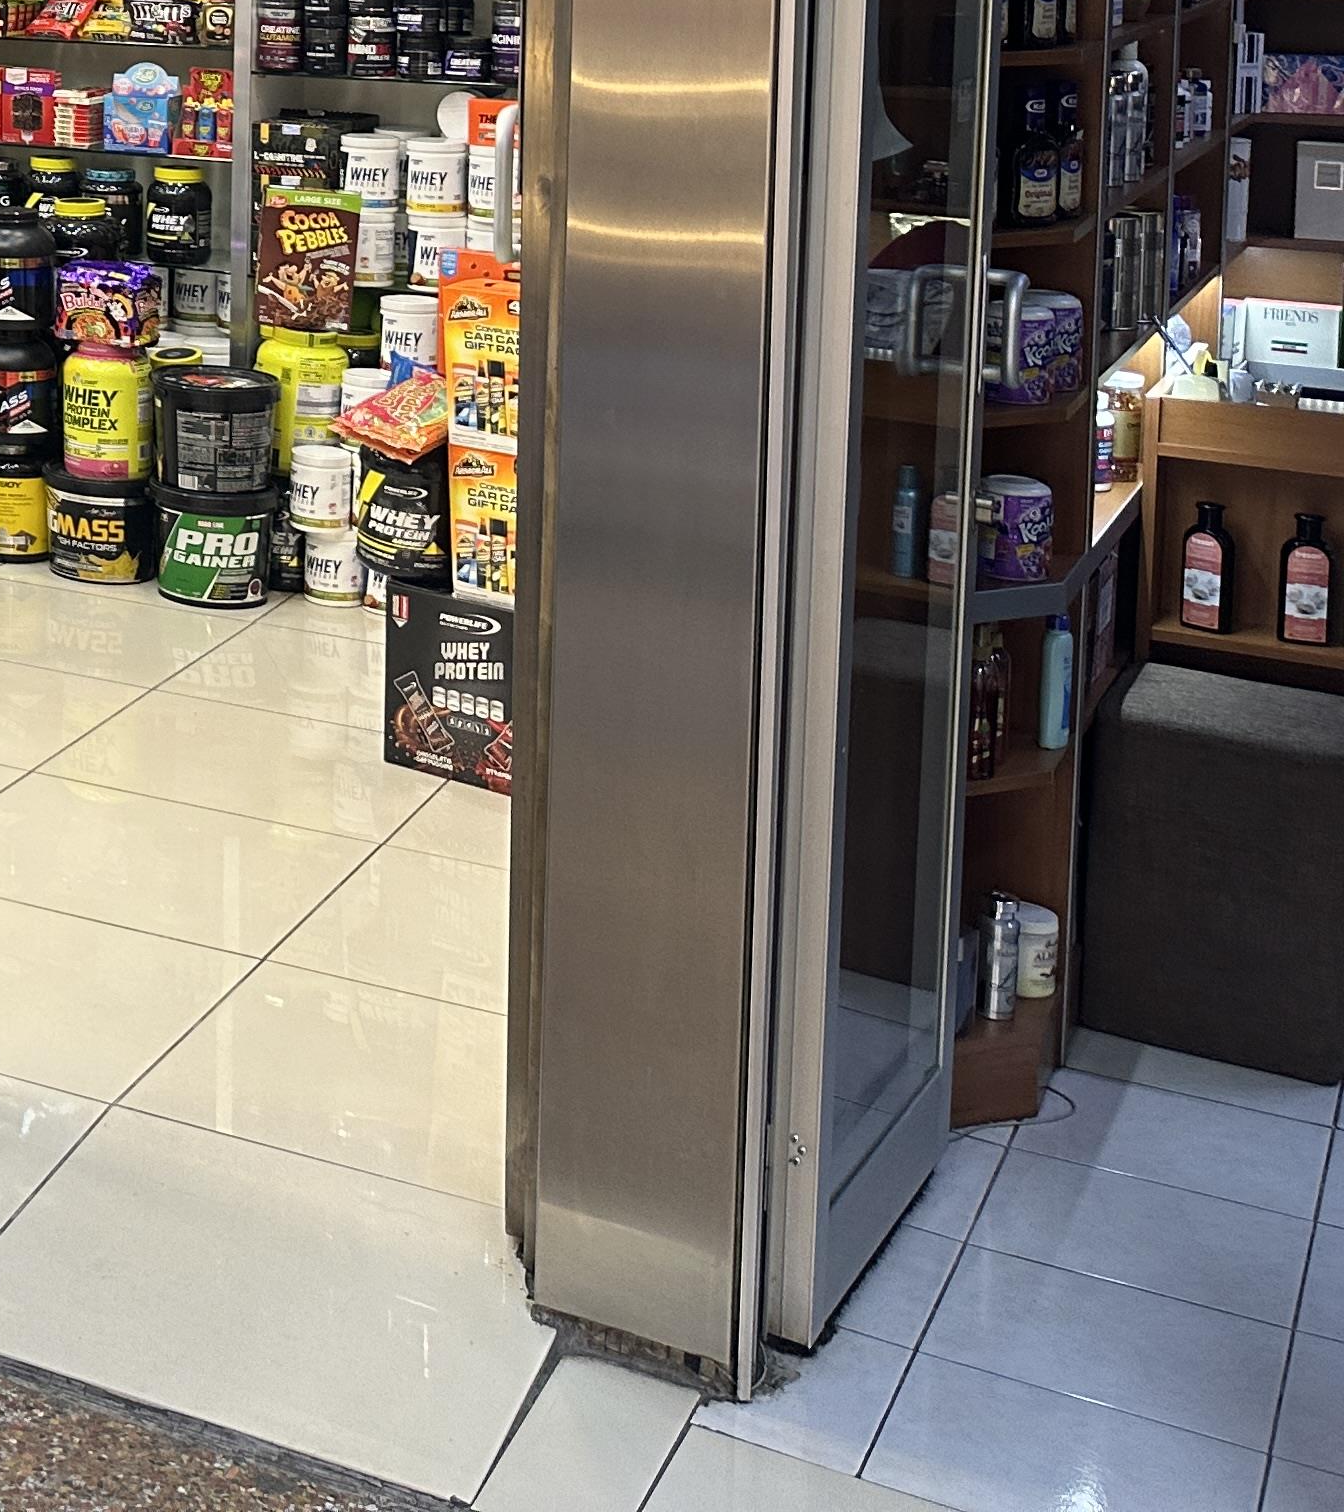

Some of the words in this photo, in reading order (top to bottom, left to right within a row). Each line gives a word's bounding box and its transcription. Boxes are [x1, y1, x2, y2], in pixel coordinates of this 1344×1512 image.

[350, 167, 389, 181] WHEY
[411, 171, 447, 186] WHEY
[294, 195, 319, 204] LARGE
[321, 196, 341, 206] SIZE
[151, 214, 189, 226] WHEY
[279, 209, 341, 230] COCOA
[276, 227, 350, 255] PEBBLES
[175, 284, 208, 299] WHEY
[1264, 306, 1319, 324] FRIENDS
[384, 330, 423, 348] WHEY
[464, 331, 491, 342] CAR
[464, 342, 493, 353] GIFT
[64, 389, 121, 407] WHEY
[66, 404, 110, 417] PROTEIN
[369, 503, 441, 528] WHEY
[368, 519, 431, 542] PROTEIN
[175, 529, 259, 557] PRO
[172, 548, 256, 569] GAINER
[441, 643, 490, 660] WHEY
[434, 662, 504, 681] PROTEIN
